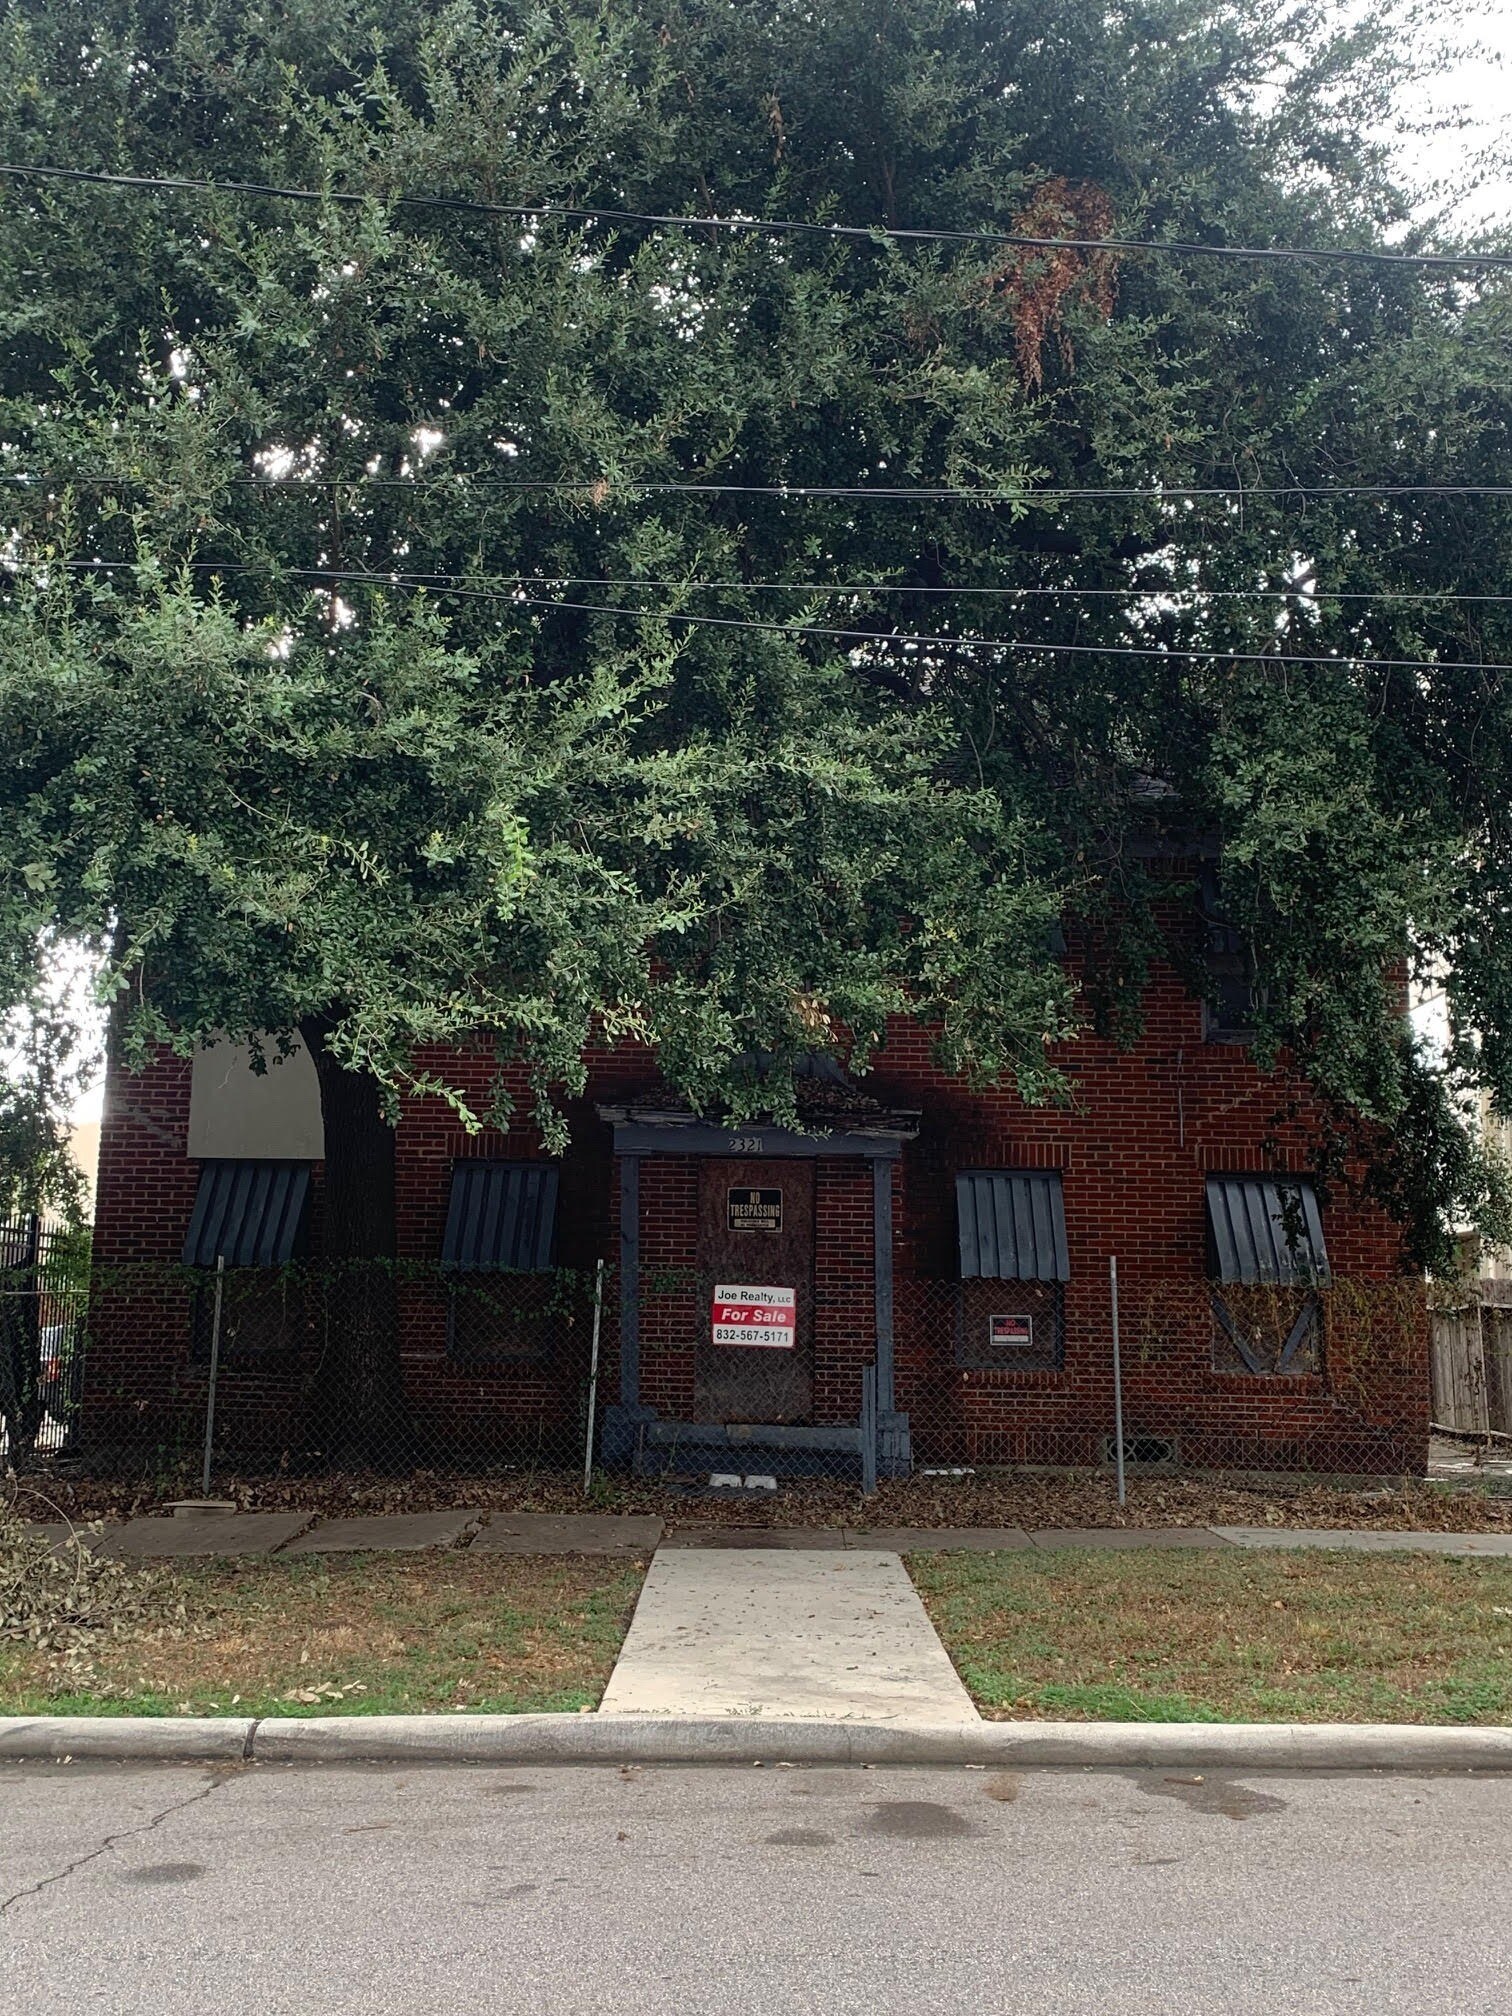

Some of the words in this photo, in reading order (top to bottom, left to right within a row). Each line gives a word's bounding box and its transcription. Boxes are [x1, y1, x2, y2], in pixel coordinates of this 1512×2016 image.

[728, 1137, 761, 1152] 2321
[750, 1191, 760, 1204] NO
[730, 1204, 780, 1217] TRESPASSING
[718, 1290, 737, 1300] Joe
[740, 1291, 775, 1304] Realty,
[721, 1308, 749, 1321] For
[753, 1309, 786, 1322] Sale
[716, 1328, 788, 1342] 832-567-5171
